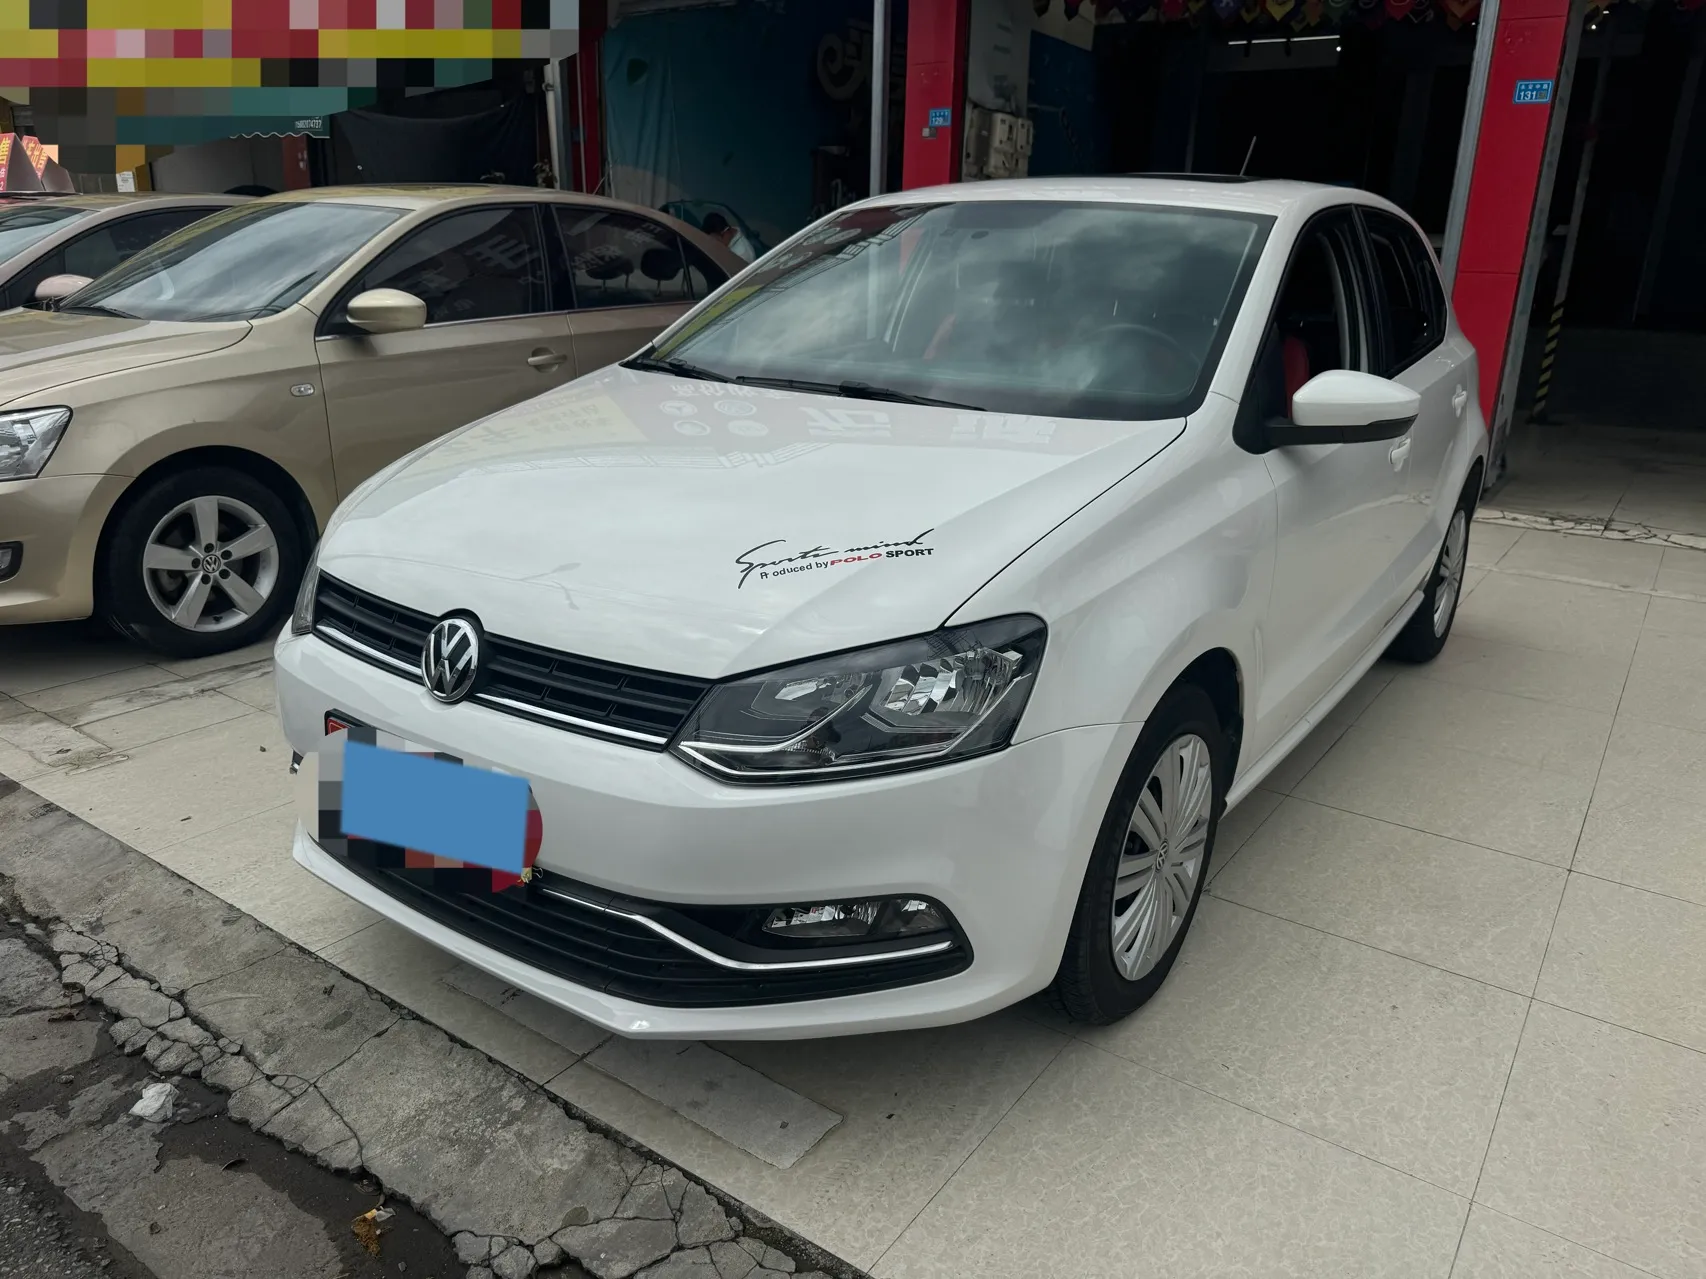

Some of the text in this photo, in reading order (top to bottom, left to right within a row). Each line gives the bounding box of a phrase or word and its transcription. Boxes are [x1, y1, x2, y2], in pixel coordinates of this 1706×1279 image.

[1520, 91, 1536, 100] 131
[815, 559, 829, 570] by
[830, 552, 883, 566] POLO
[885, 548, 935, 558] SPORT
